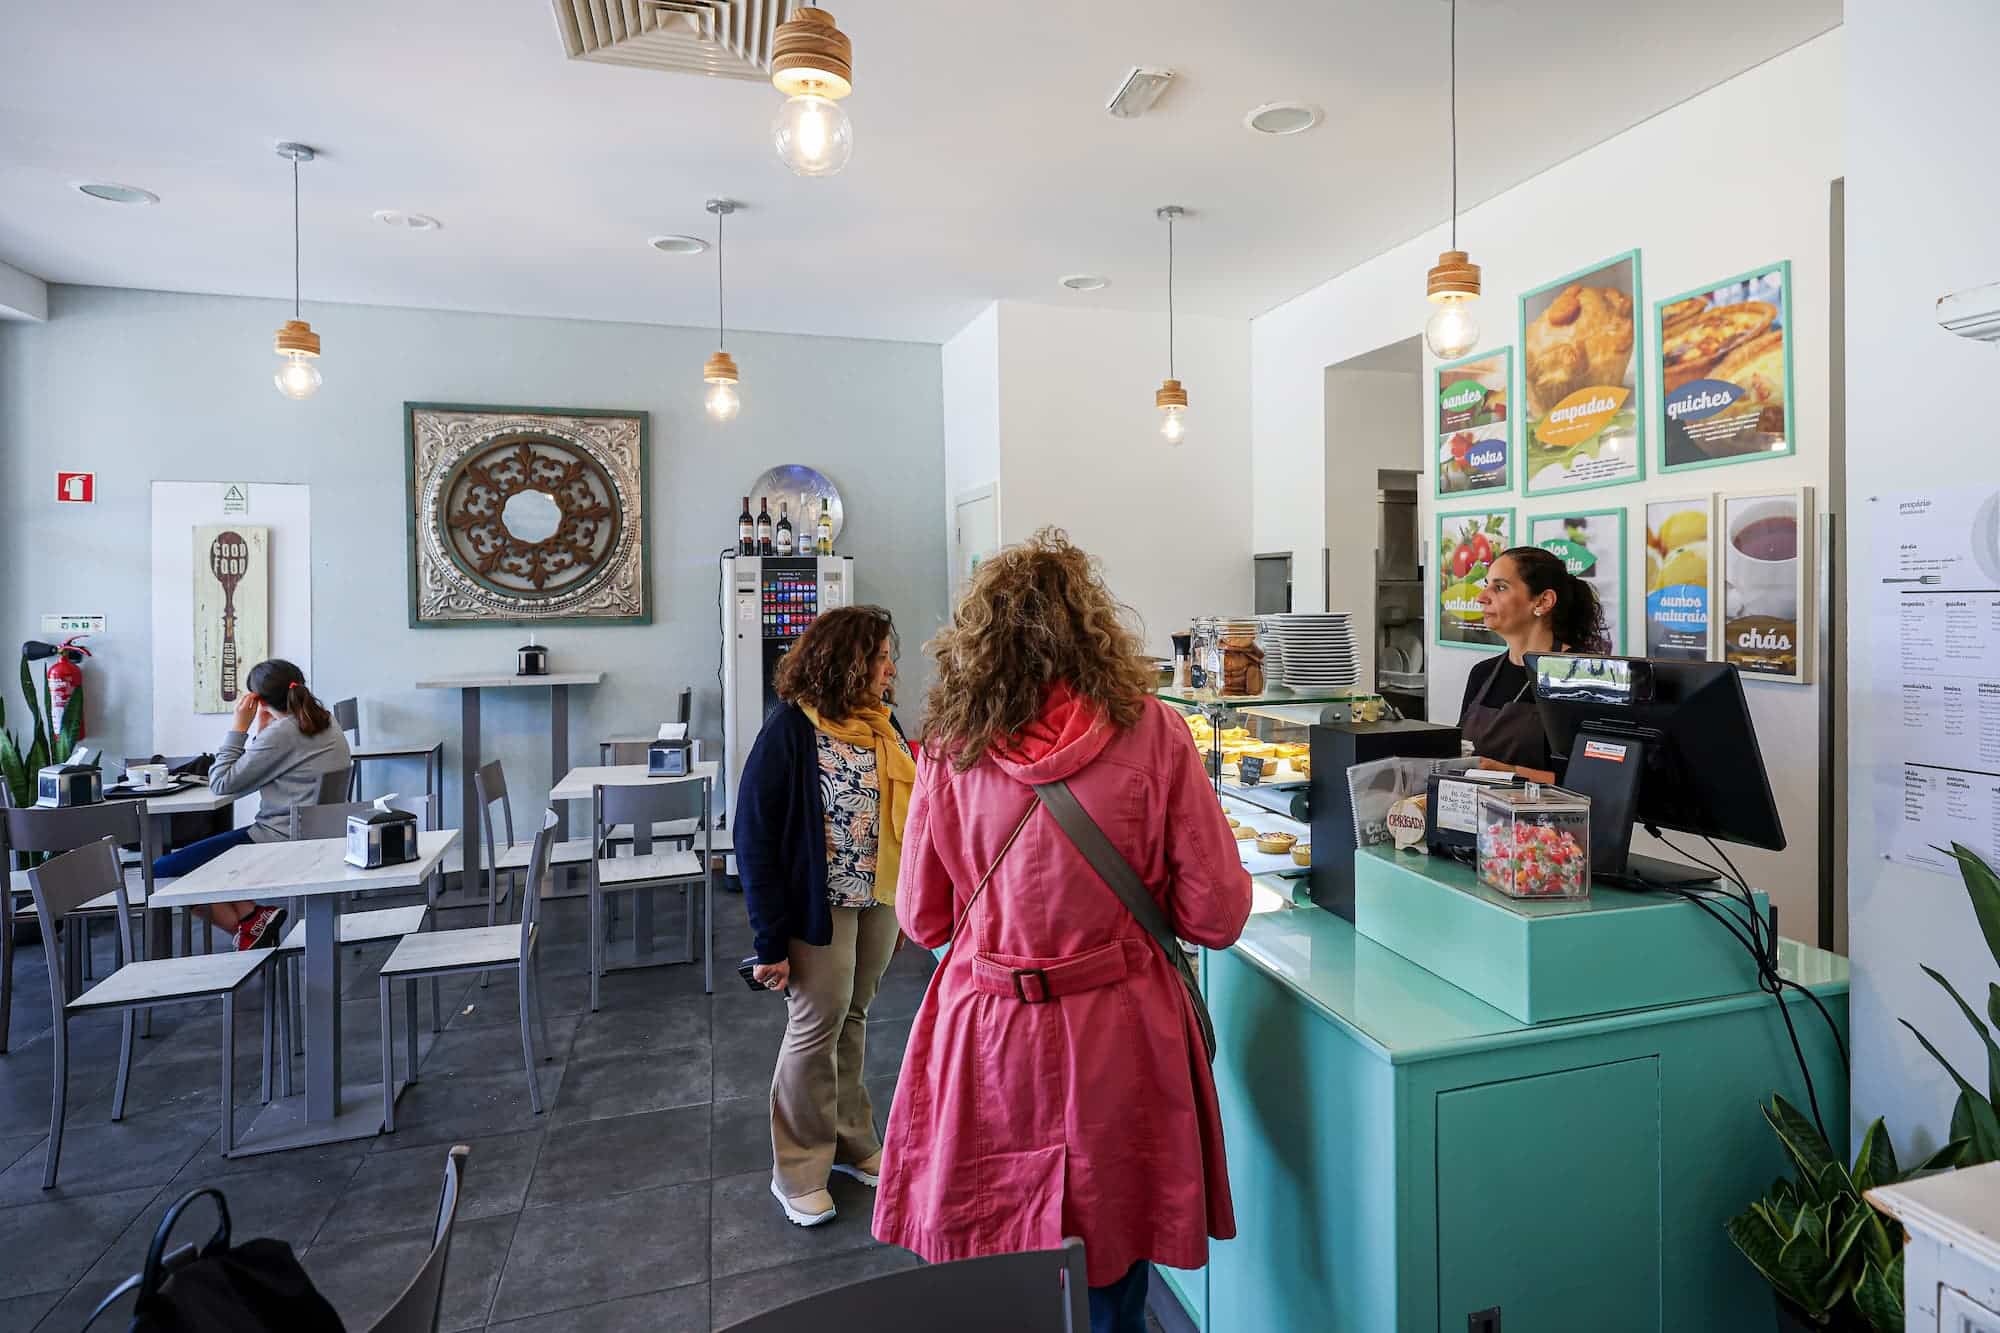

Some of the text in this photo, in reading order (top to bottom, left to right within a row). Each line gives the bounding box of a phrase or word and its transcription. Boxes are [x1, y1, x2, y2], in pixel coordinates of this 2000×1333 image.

[1442, 389, 1481, 409] sandes
[1667, 389, 1733, 420] quiches
[1550, 394, 1617, 423] empadas
[1470, 450, 1504, 466] tostas
[213, 543, 247, 557] GOOD
[214, 557, 247, 575] FOOD
[1444, 596, 1487, 611] salada
[1660, 596, 1702, 607] sumos
[1655, 609, 1707, 623] naturais
[1738, 627, 1793, 650] chás
[223, 642, 236, 665] GOOD
[1388, 813, 1425, 830] OBRIGADA
